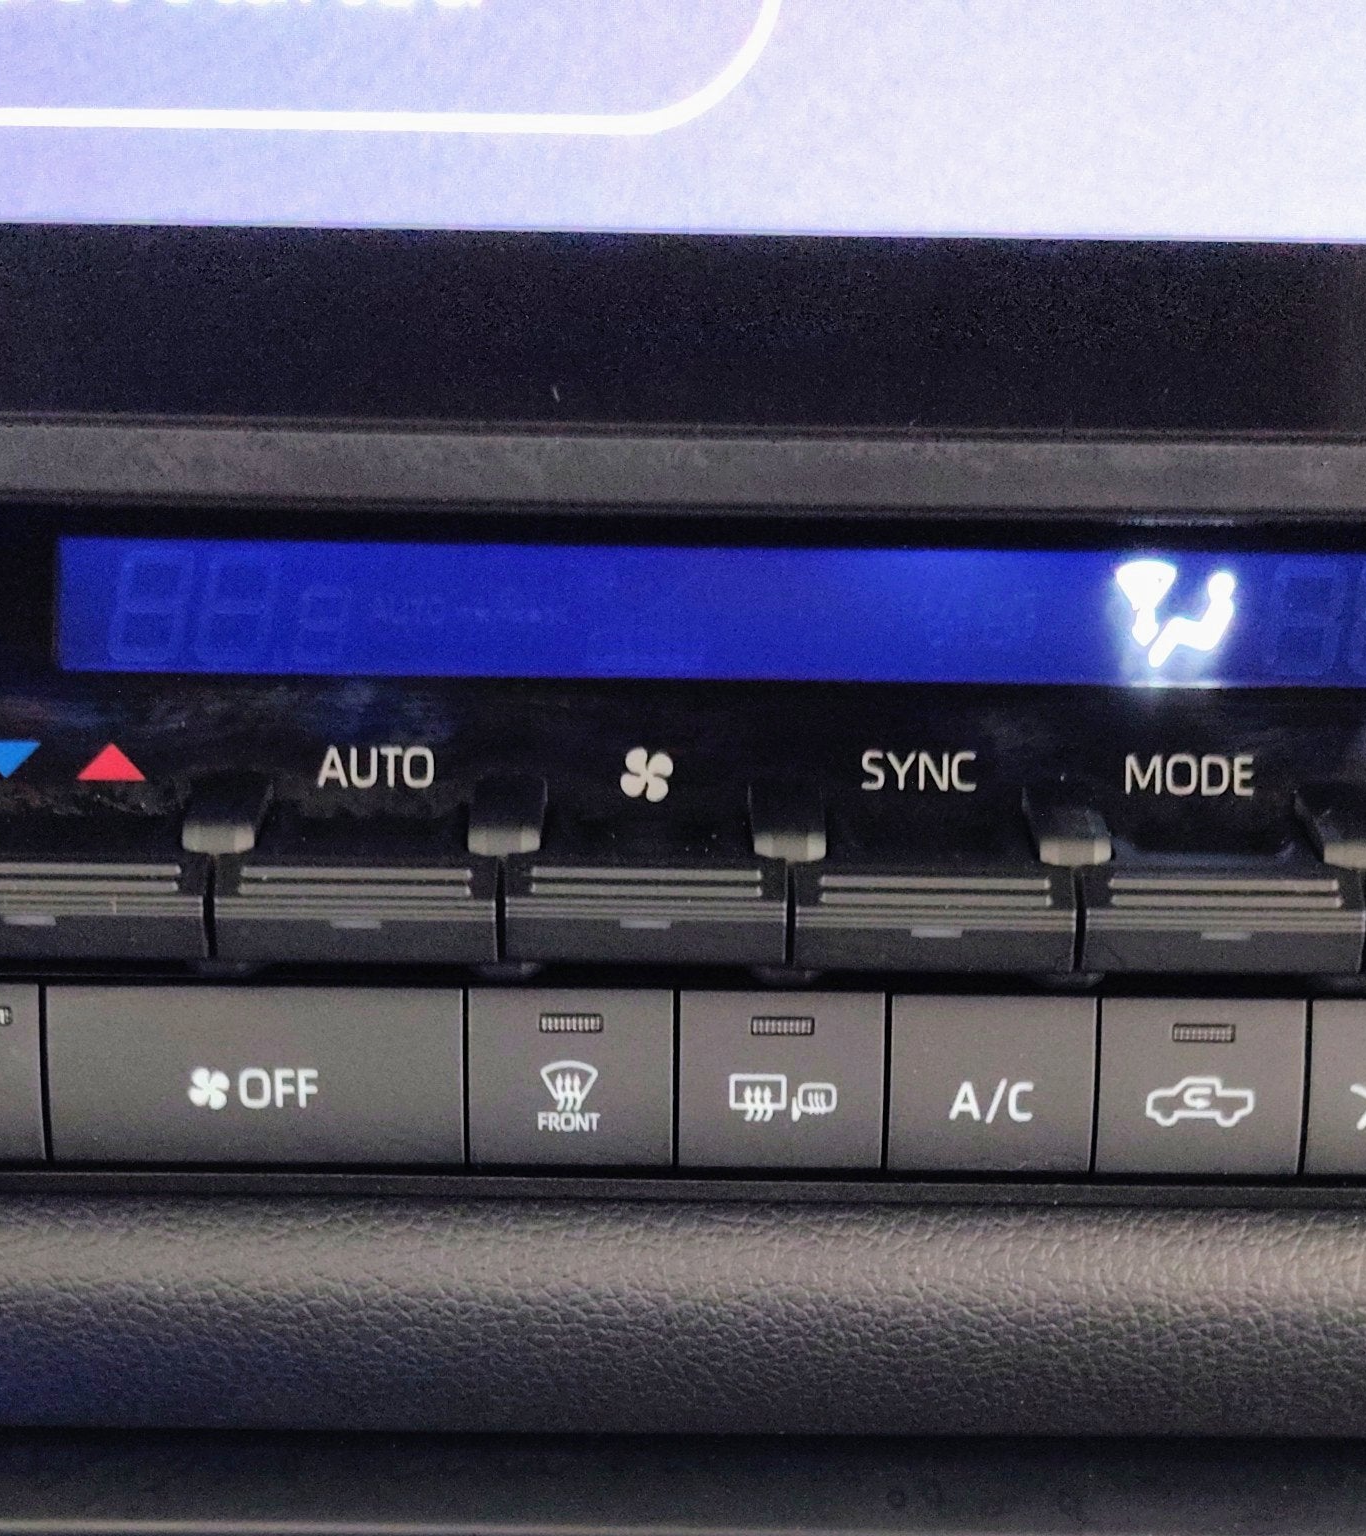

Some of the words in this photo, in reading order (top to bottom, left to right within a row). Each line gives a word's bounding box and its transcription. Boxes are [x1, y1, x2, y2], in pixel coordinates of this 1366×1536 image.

[317, 744, 436, 790] AUTO
[860, 748, 978, 793] SYNC
[1123, 752, 1255, 798] MODE
[238, 1066, 320, 1109] OFF
[948, 1077, 1035, 1125] A/C
[536, 1111, 601, 1133] FRONT
